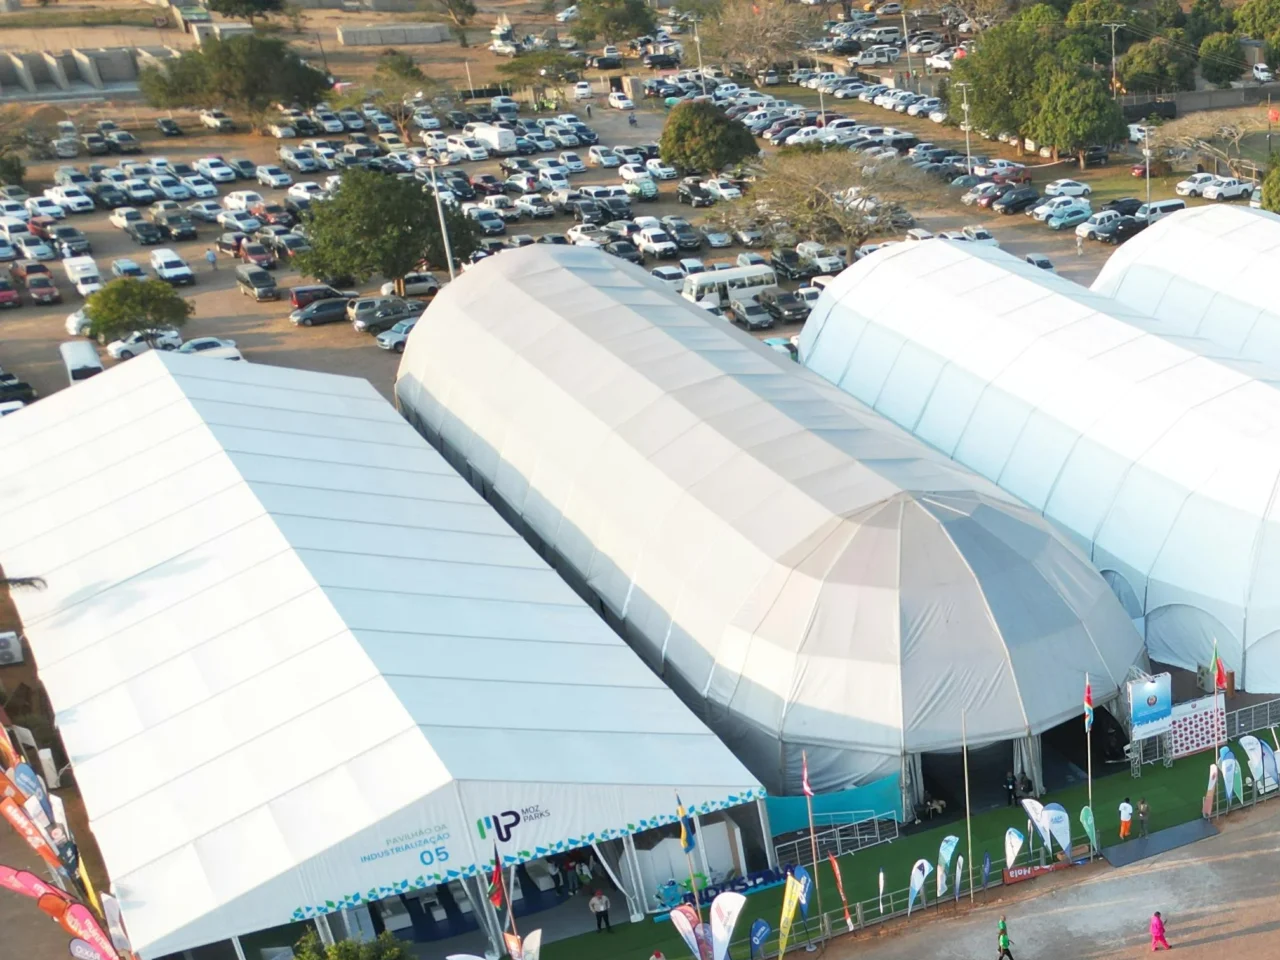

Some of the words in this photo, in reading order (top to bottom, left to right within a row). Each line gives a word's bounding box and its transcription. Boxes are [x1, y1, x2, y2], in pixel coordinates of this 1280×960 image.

[521, 804, 540, 816] MOZ
[523, 809, 551, 823] PARKS
[385, 827, 433, 847] PAVILHÃO
[434, 823, 449, 833] DA
[360, 831, 451, 863] INDUSTRIALIZAÇÃO
[419, 846, 450, 866] 05
